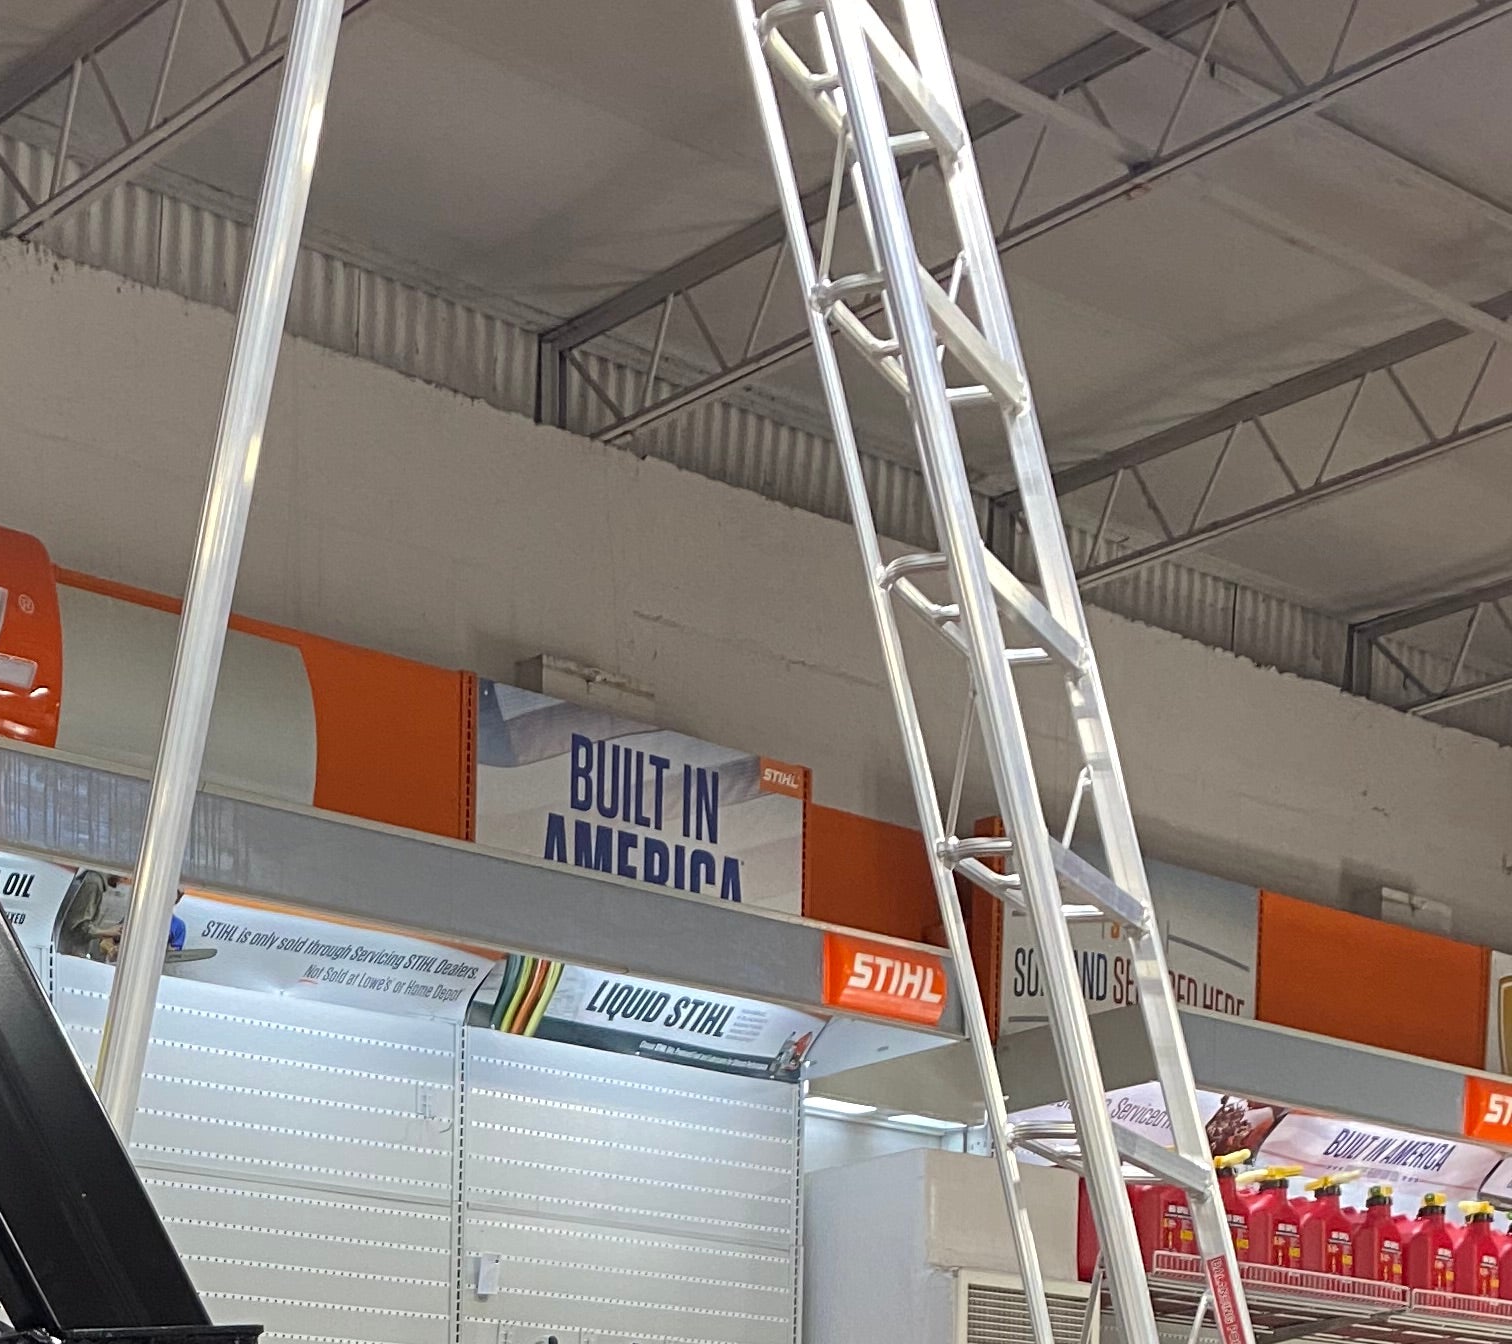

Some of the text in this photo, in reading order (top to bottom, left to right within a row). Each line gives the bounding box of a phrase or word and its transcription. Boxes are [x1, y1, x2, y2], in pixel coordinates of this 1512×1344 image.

[570, 732, 719, 845] BUILT IN
[762, 767, 799, 789] STIHL
[544, 812, 742, 903] AMERICA
[2, 872, 36, 898] OIL
[201, 919, 479, 980] STIHL is only sold through Servicing STIHL Dealers.
[303, 964, 463, 1002] Not Sold at Lowe's or Home Depot
[847, 951, 943, 1004] STIHL
[586, 979, 668, 1022] LIQUID
[663, 995, 735, 1038] STIHL
[1323, 1128, 1457, 1172] BUILT IN AMERICA
